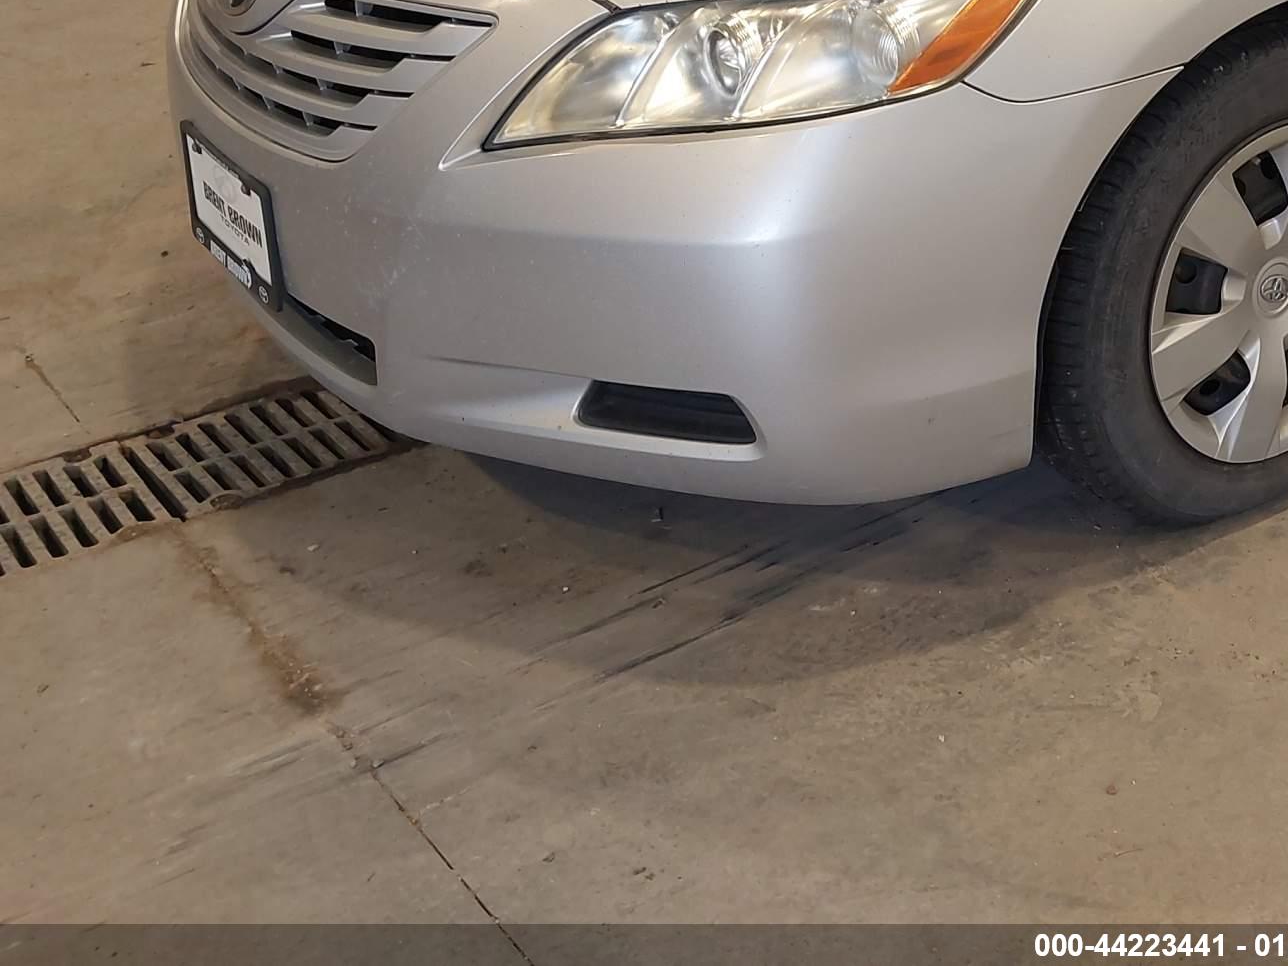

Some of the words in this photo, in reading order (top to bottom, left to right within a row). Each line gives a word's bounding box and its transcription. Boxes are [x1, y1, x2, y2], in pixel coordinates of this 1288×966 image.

[203, 180, 227, 217] BRENT
[228, 205, 263, 248] BROWN
[219, 214, 251, 247] TOYOTA
